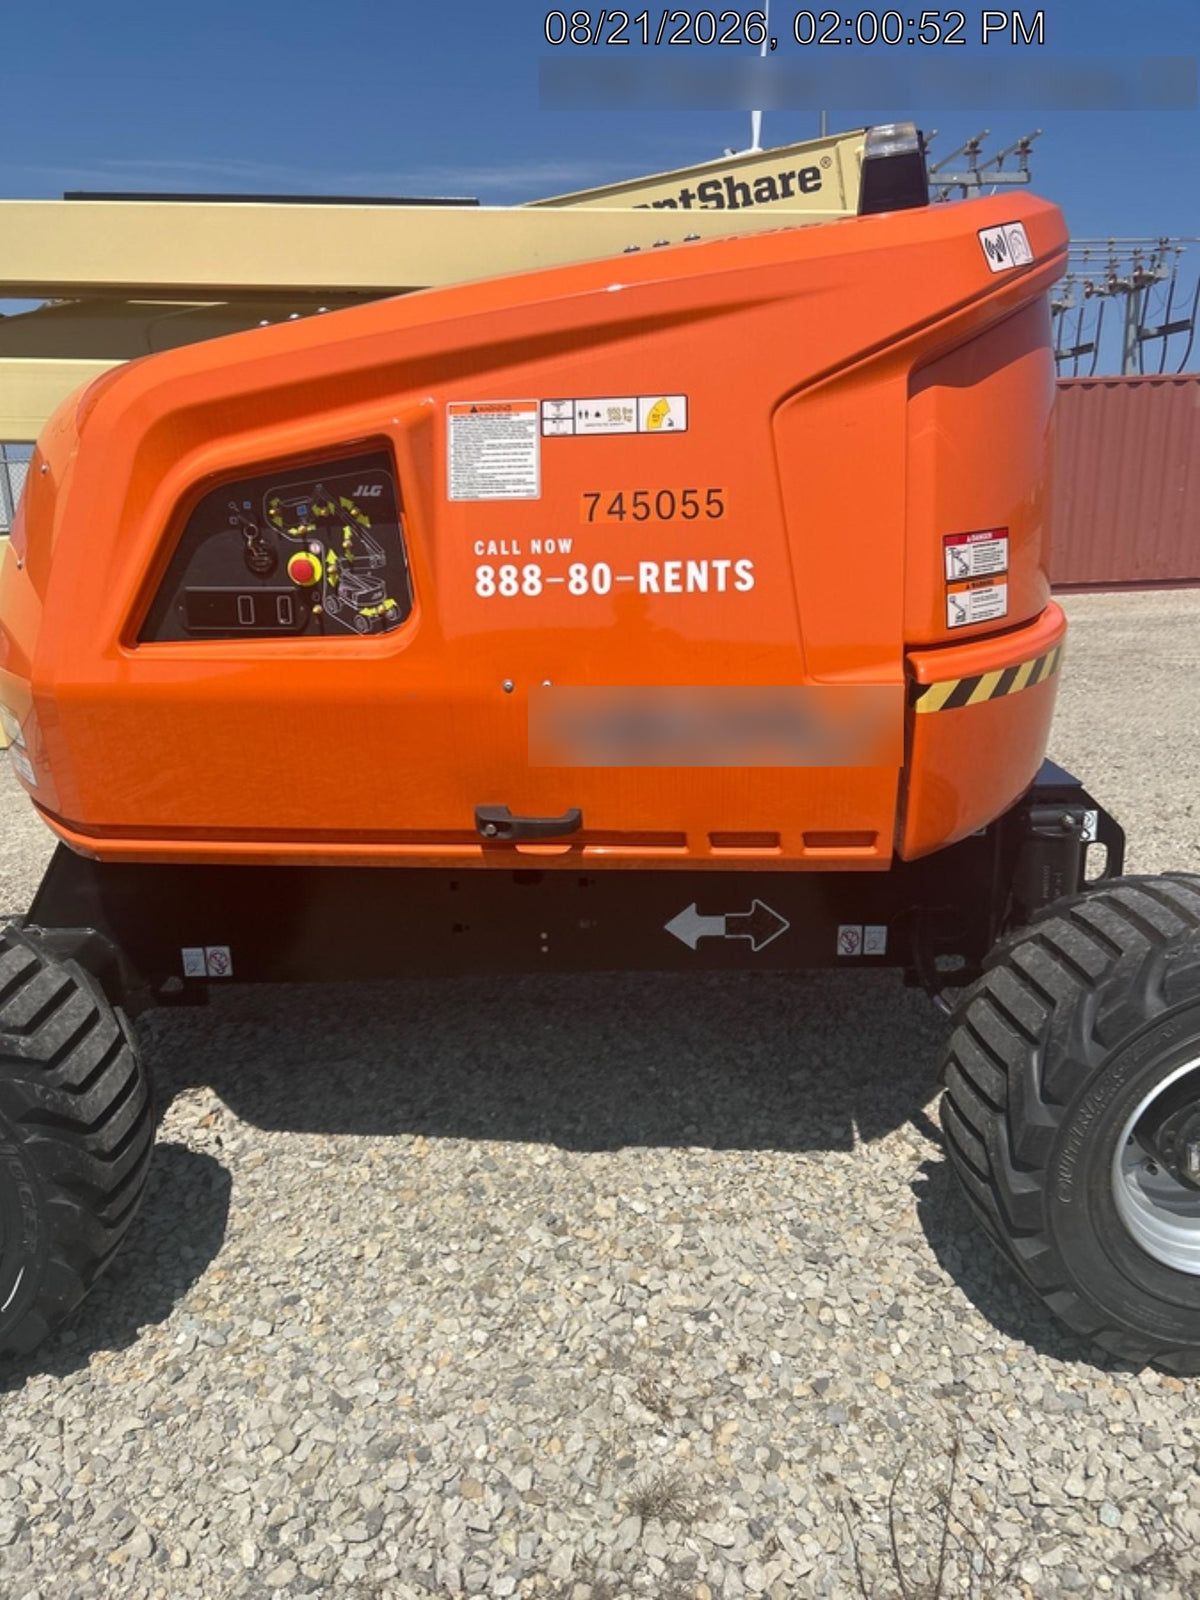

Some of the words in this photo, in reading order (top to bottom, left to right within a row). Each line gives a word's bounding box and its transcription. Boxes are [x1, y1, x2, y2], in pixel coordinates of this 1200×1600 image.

[353, 485, 382, 497] JLG
[583, 488, 725, 523] 745055
[474, 540, 521, 556] CALL
[531, 538, 573, 555] NOW
[475, 559, 755, 598] 888-80-RENTS
